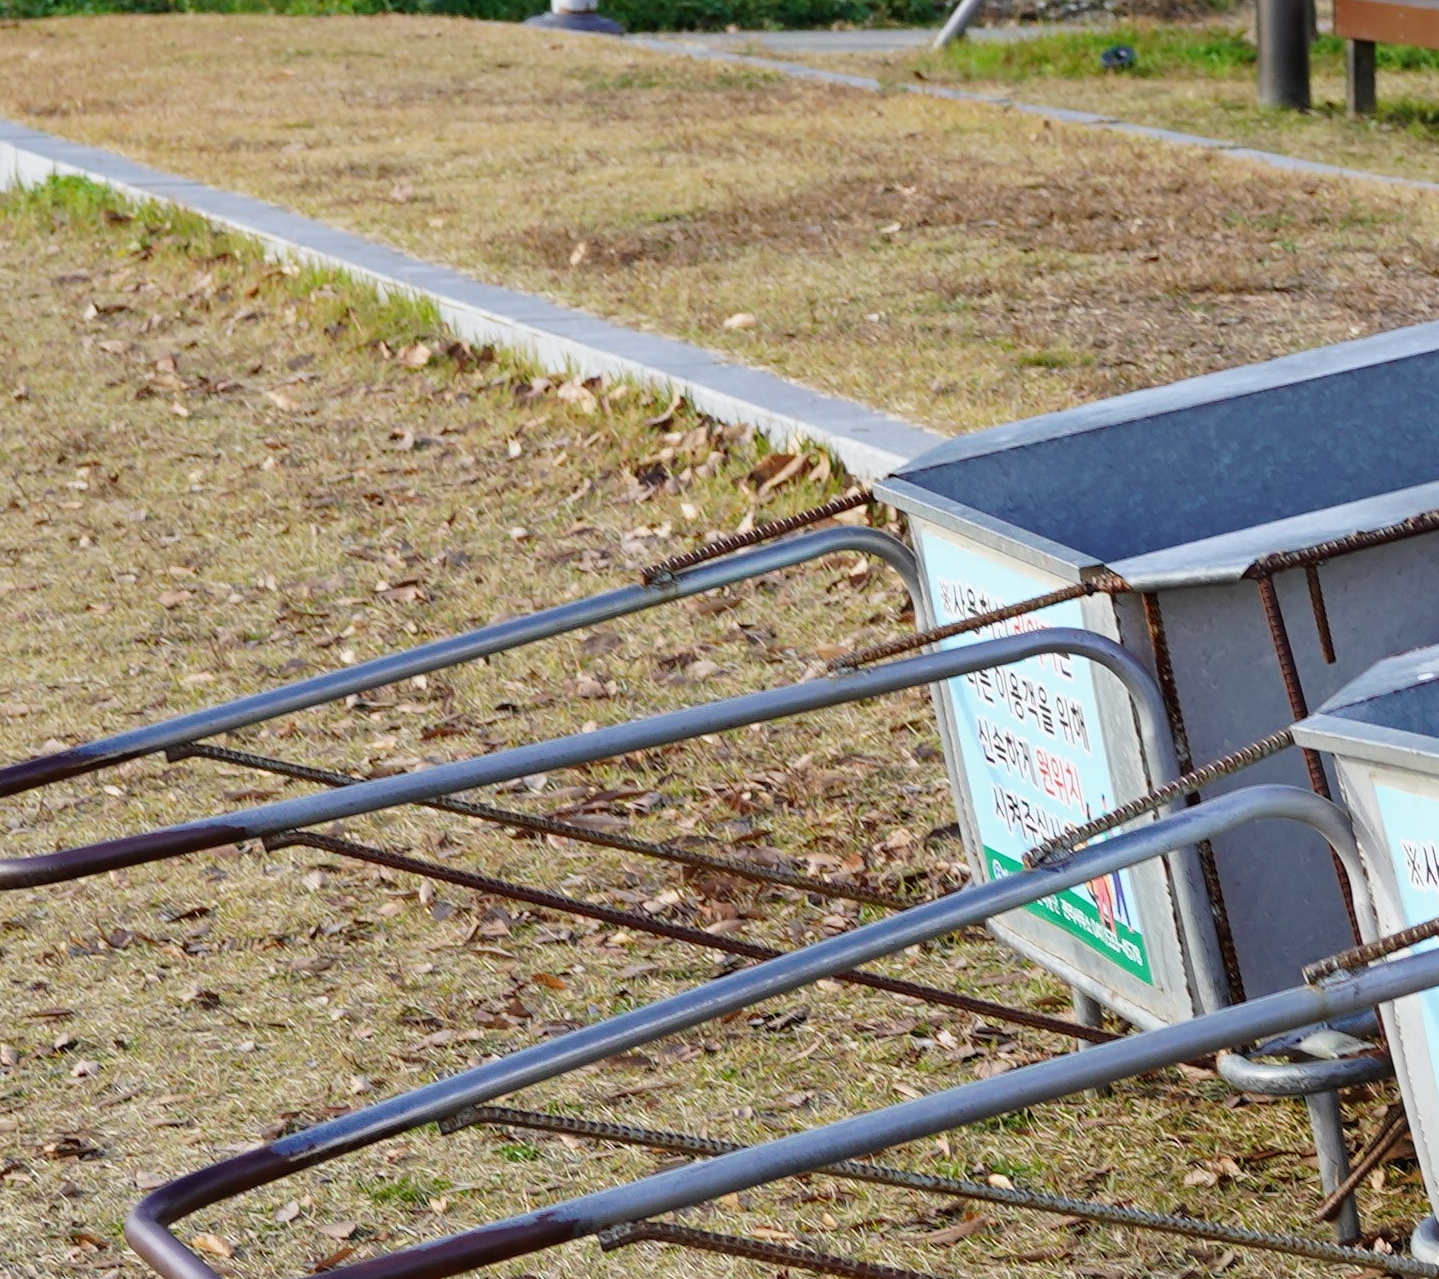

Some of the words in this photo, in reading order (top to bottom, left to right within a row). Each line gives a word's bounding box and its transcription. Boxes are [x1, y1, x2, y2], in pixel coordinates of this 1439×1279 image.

[995, 666, 1055, 735] 이용객을
[1056, 696, 1091, 753] 위해
[977, 718, 1039, 788] 신속하게
[1036, 749, 1085, 813] 원위치
